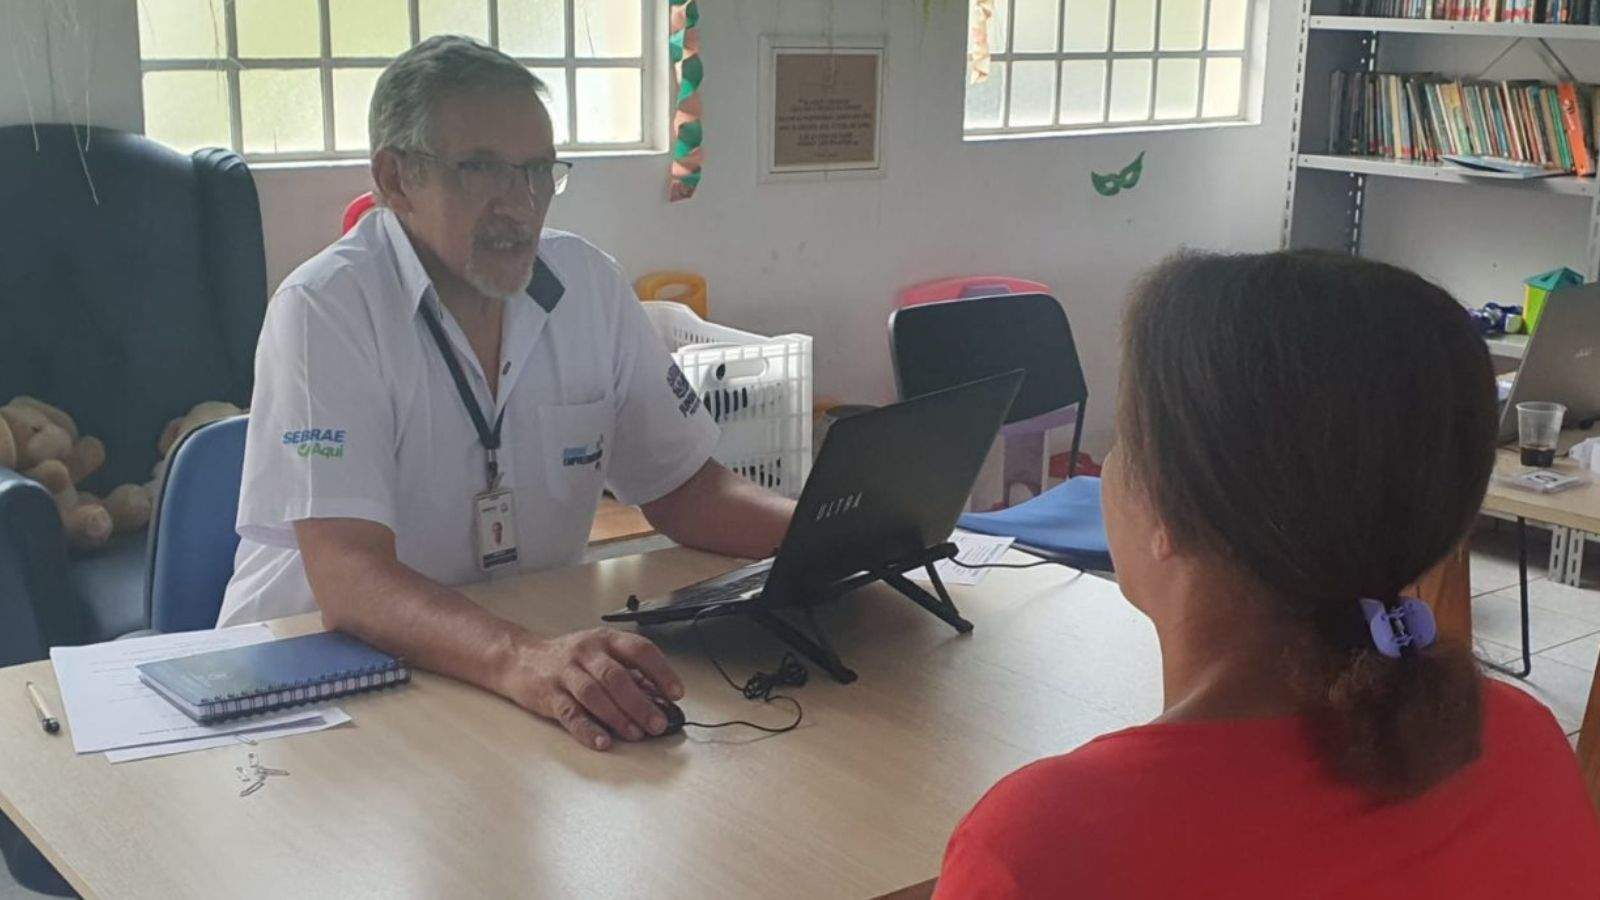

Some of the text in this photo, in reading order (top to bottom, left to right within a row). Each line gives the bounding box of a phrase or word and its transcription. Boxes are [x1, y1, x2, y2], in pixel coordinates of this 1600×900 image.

[282, 428, 346, 444] SEBRAE
[311, 443, 344, 459] Aqui
[816, 491, 862, 521] ULTRA
